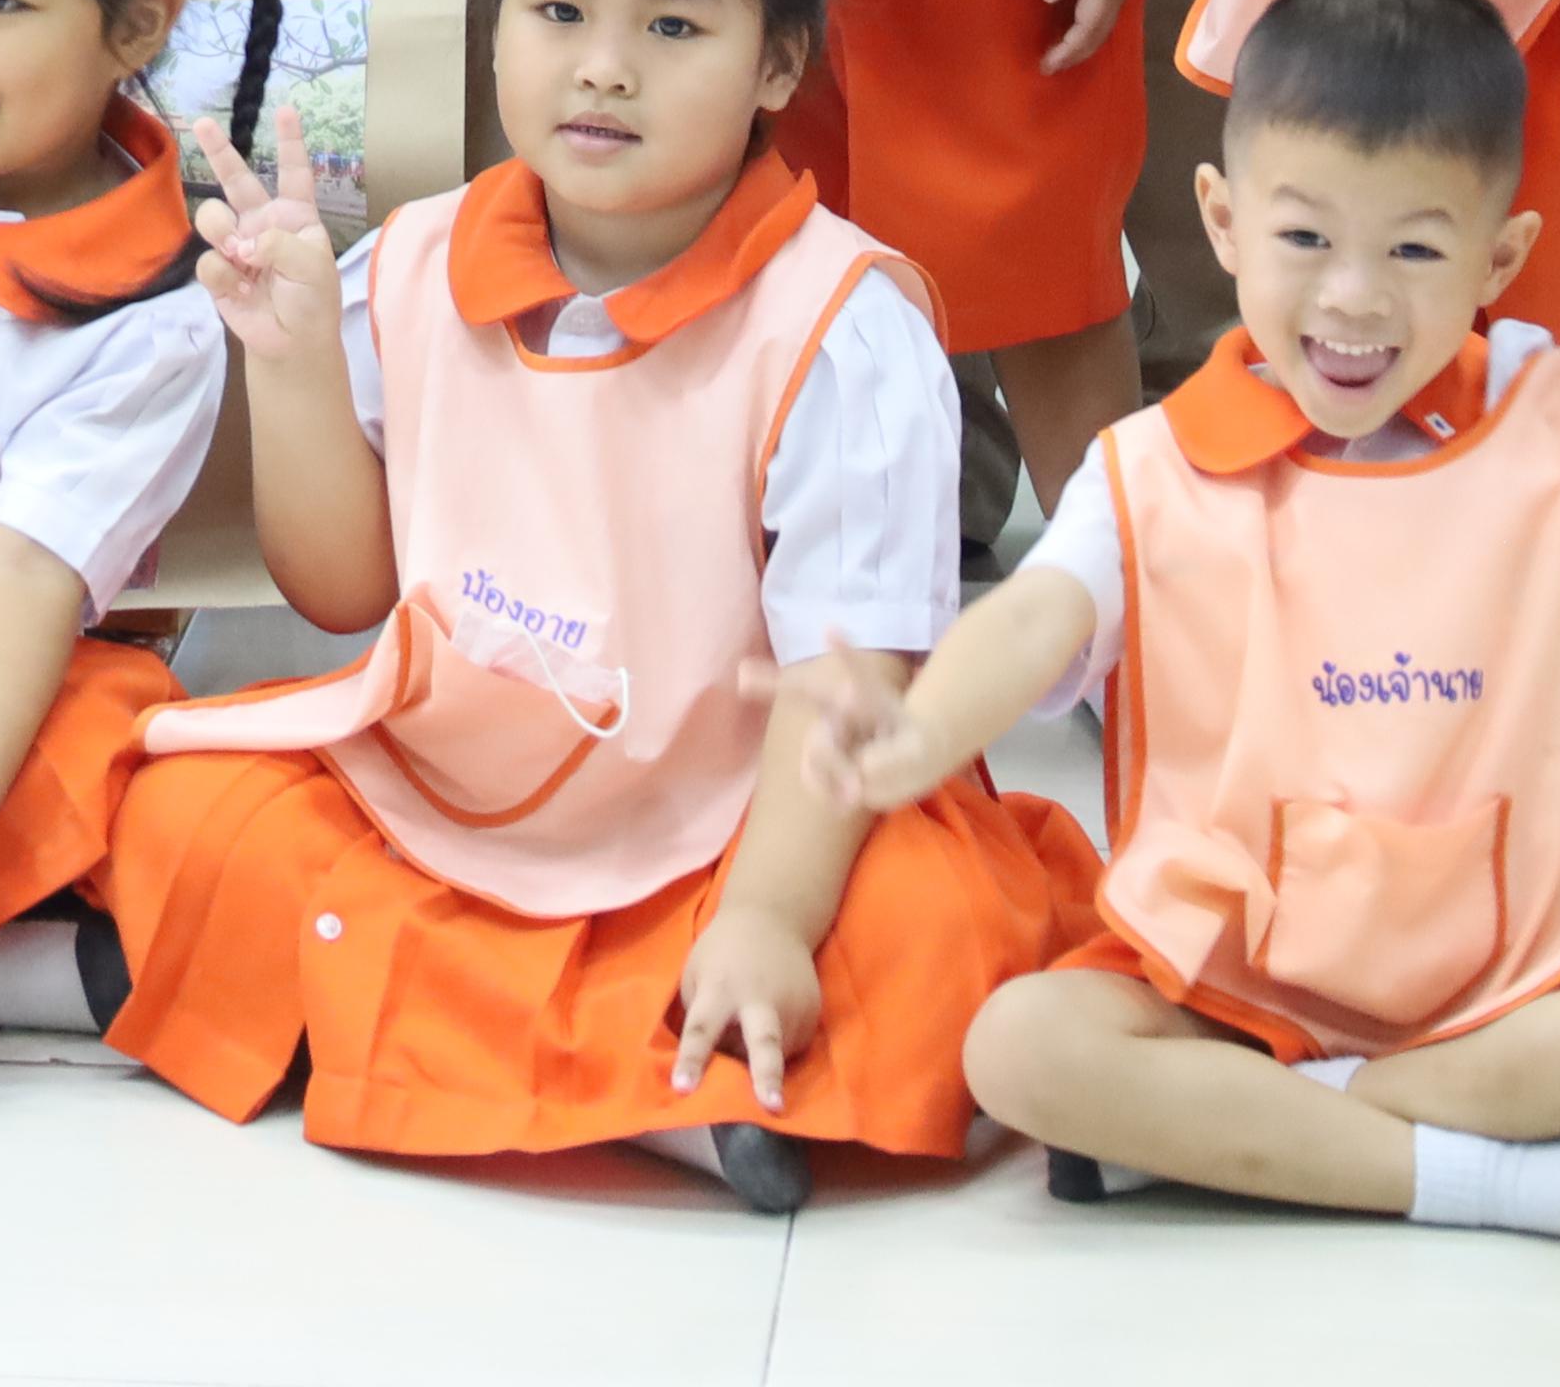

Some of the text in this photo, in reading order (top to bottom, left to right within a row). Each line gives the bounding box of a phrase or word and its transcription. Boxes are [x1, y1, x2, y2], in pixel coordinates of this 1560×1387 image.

[462, 569, 588, 650] น้องอาย
[1311, 650, 1484, 705] น้องเจ้านาย
